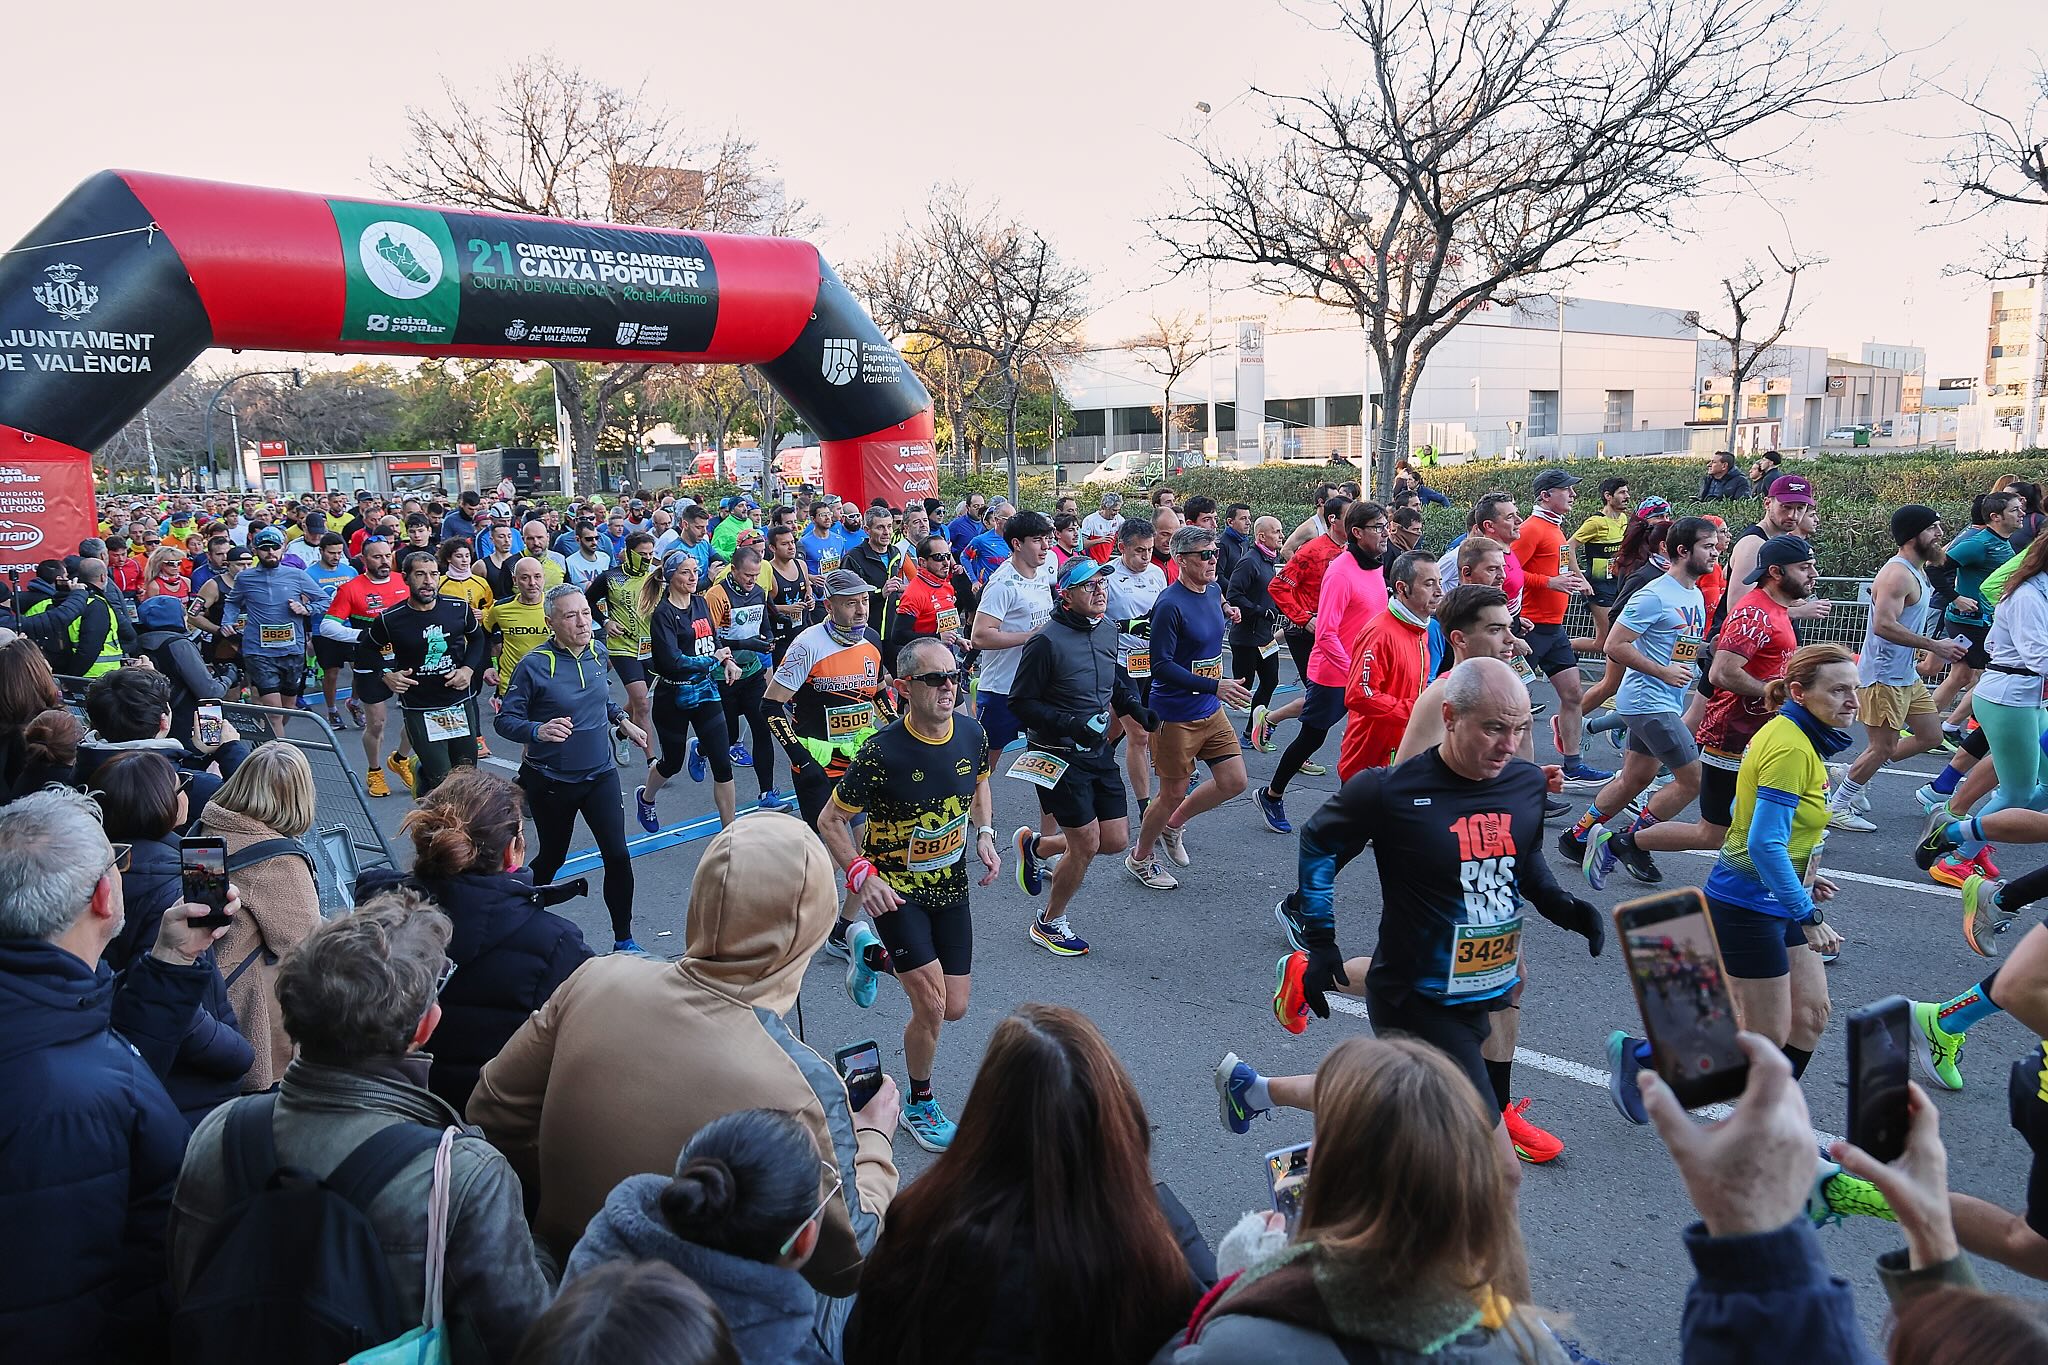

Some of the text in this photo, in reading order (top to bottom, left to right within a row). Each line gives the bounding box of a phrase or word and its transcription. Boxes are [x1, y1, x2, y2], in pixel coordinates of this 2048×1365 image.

[468, 239, 514, 275] 21
[516, 243, 706, 272] CIRCUIT DE CARRERES
[520, 257, 699, 288] CAIXA POPULAR
[473, 277, 608, 297] CIUTAT DE VALÈNCIA
[391, 324, 446, 333] popular
[392, 316, 428, 326] caixa
[531, 326, 591, 335] AJUNTAMENT
[543, 334, 587, 343] VALÈNCIA
[32, 351, 152, 373] VALÈNCIA
[862, 352, 899, 364] Esportiva
[862, 363, 903, 374] Municipal
[862, 373, 900, 383] València
[0, 531, 38, 541] rrano
[262, 630, 291, 639] 3629
[695, 636, 716, 655] PAS
[813, 682, 847, 692] QUART
[848, 681, 859, 689] DE
[831, 712, 868, 728] 3509
[1017, 757, 1057, 774] 3343
[914, 830, 959, 855] 3872
[1449, 813, 1517, 861] 10K
[1460, 856, 1515, 893] PAS
[1464, 885, 1515, 925] RAS
[1458, 934, 1514, 963] 3424
